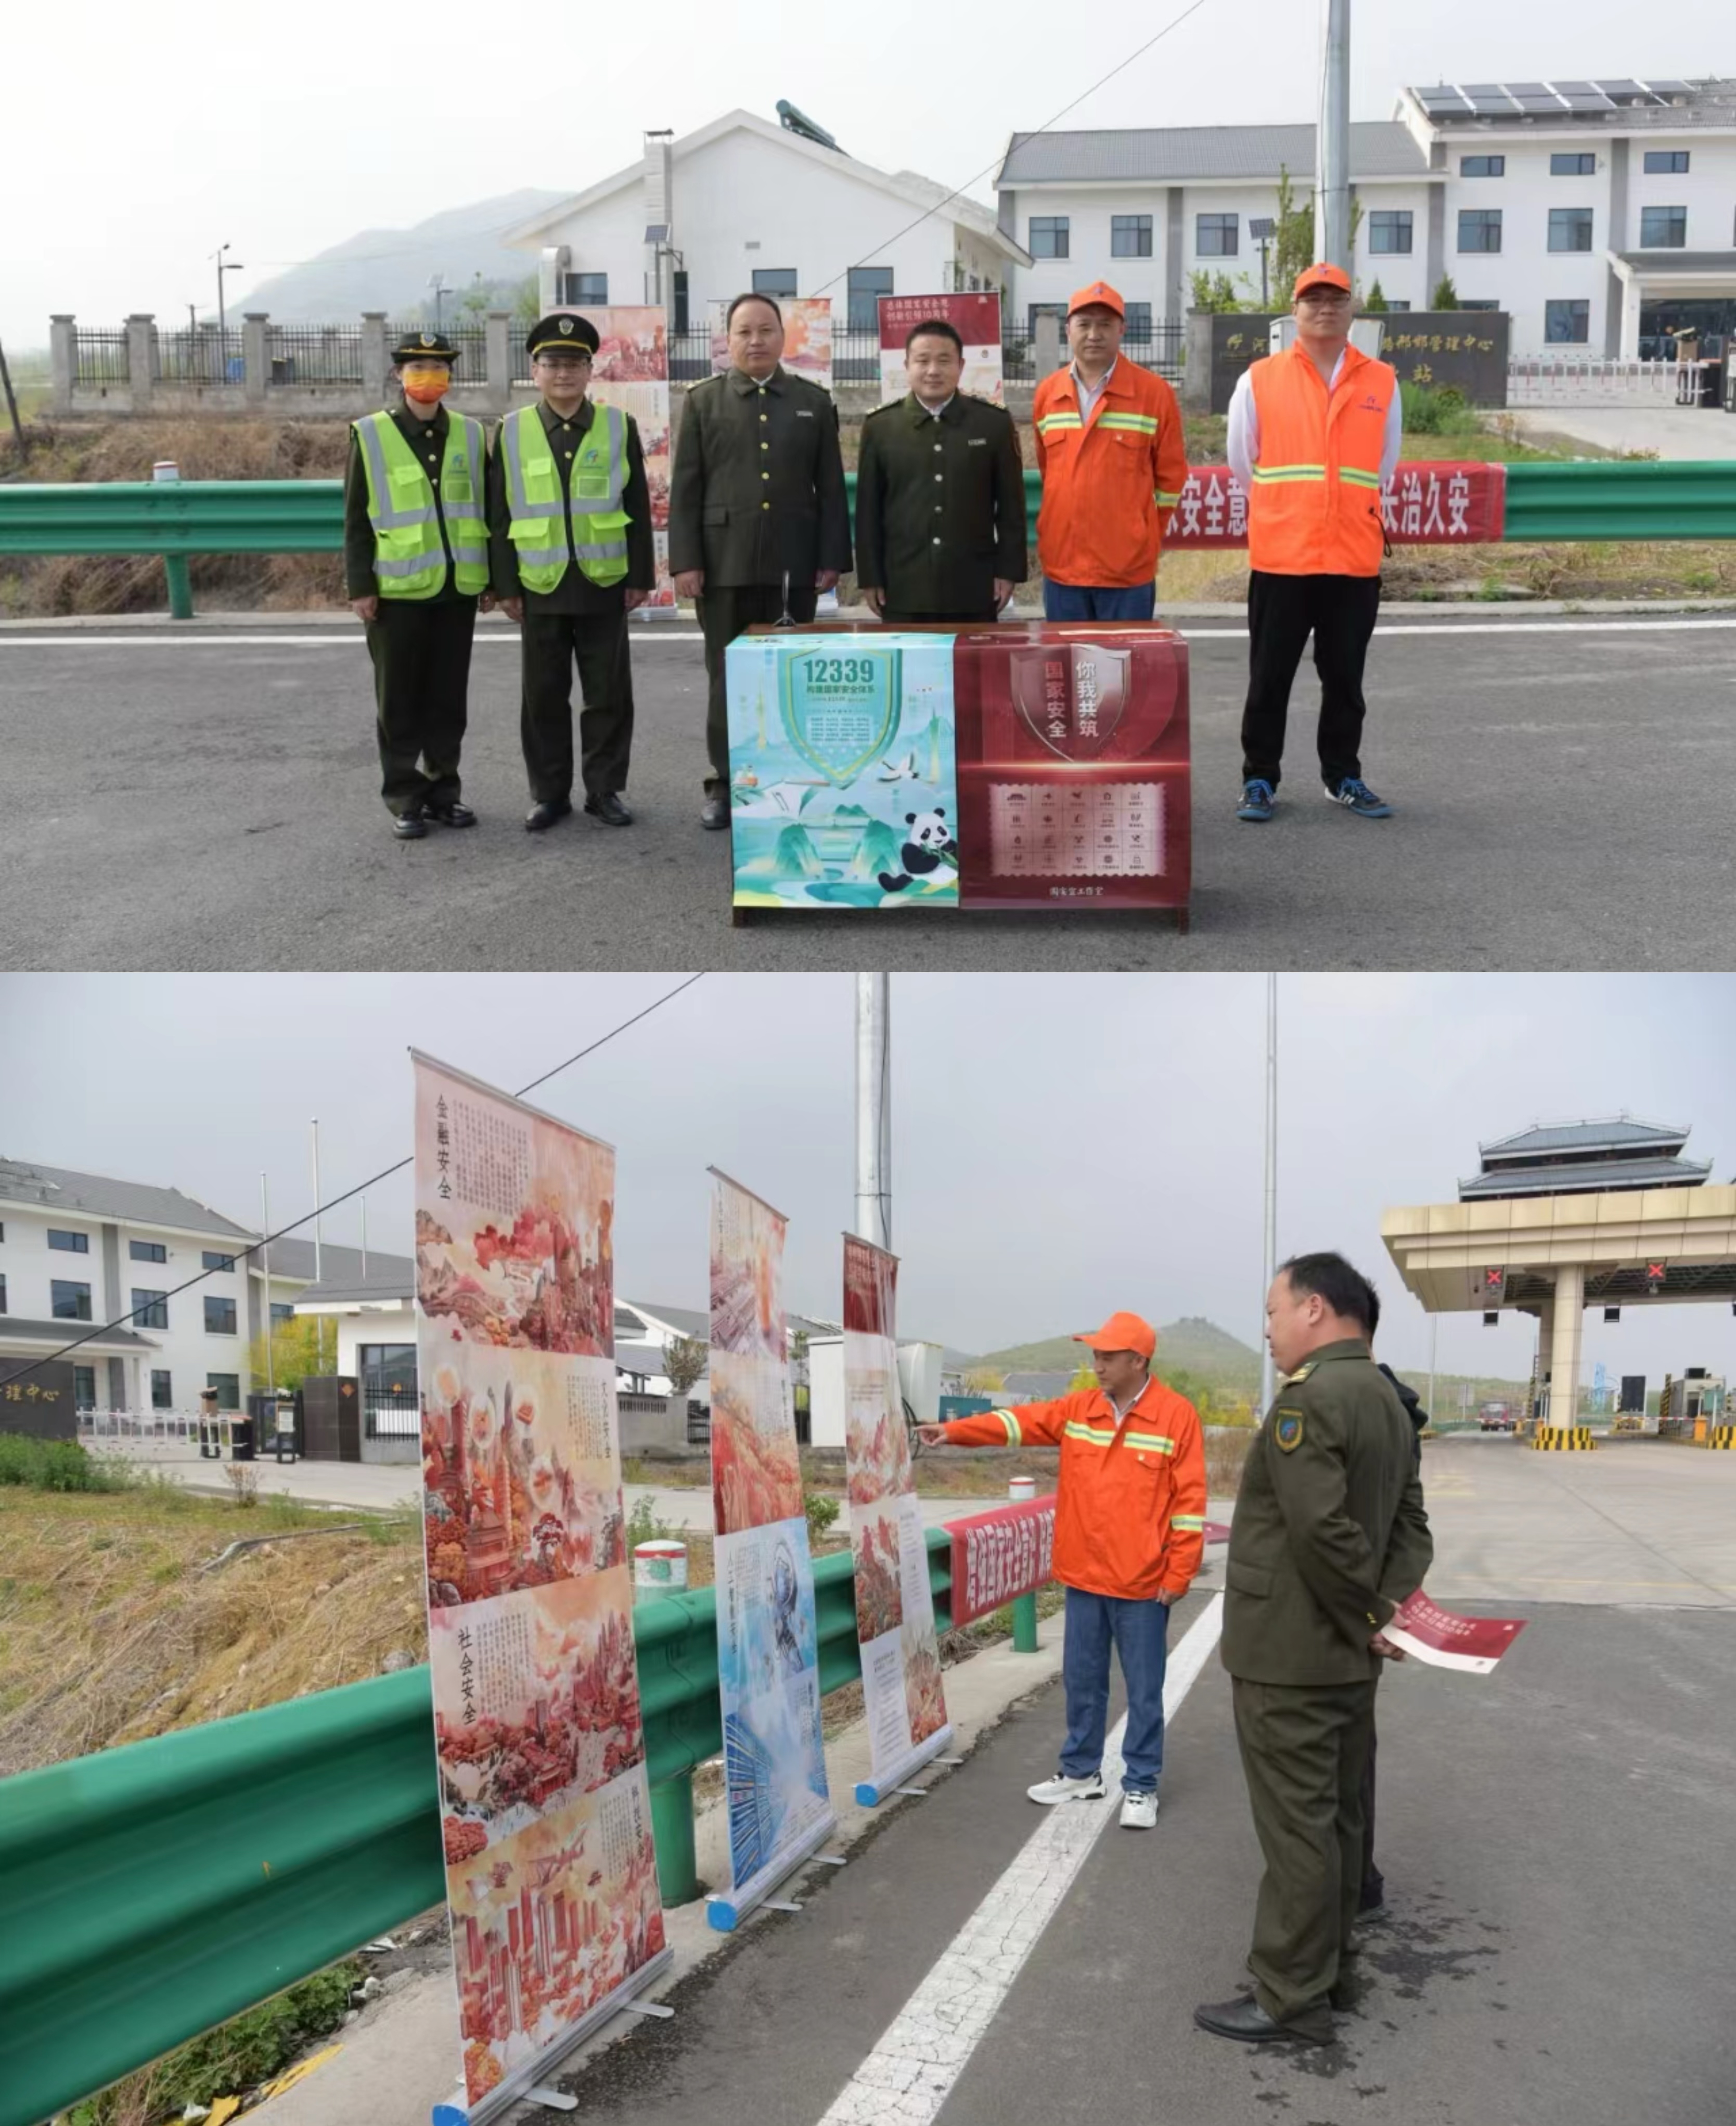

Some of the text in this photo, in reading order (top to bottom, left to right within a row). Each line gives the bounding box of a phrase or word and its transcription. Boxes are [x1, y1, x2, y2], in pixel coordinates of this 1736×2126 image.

[1166, 473, 1248, 537] 安全意
[1381, 471, 1469, 535] 长治久安
[803, 659, 875, 683] 12339
[1045, 661, 1067, 738] 国家安全
[1076, 661, 1099, 738] 你我共筑
[436, 1093, 452, 1200] 金融安全
[458, 1626, 477, 1725] 社会安全
